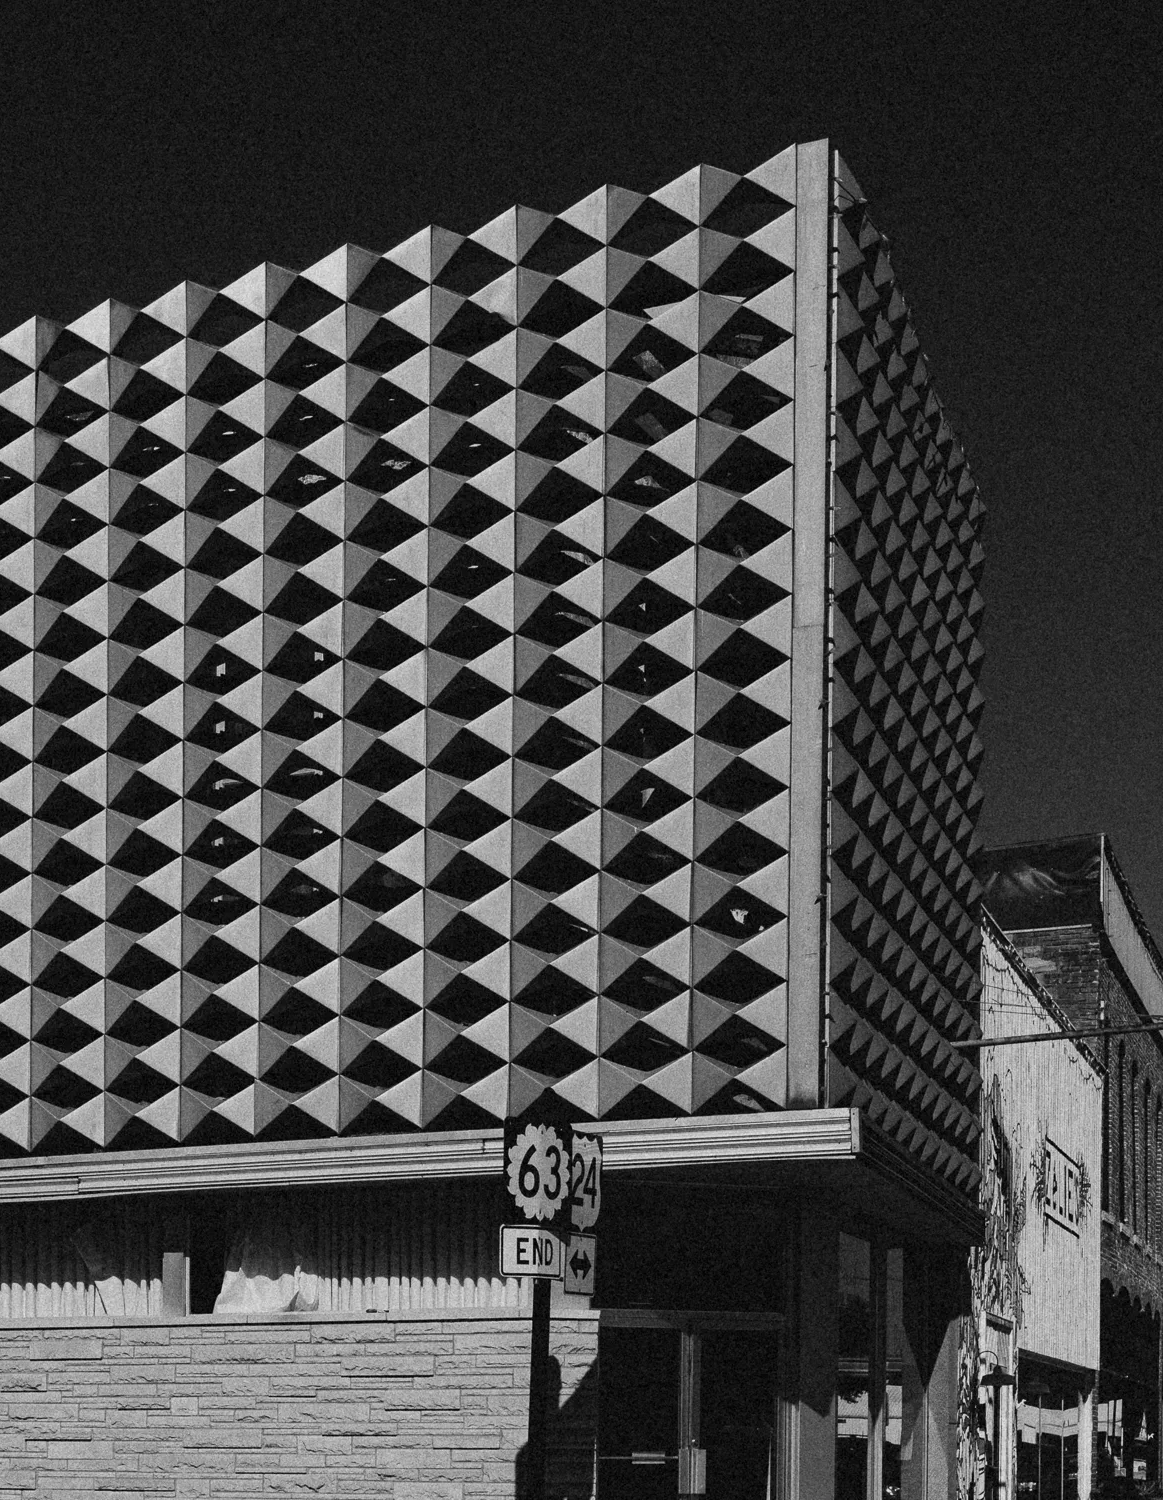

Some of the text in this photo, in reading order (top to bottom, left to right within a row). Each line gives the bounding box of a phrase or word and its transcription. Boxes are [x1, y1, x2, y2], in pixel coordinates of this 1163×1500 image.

[519, 1144, 561, 1200] 63
[571, 1153, 597, 1209] 24
[516, 1237, 553, 1266] END
